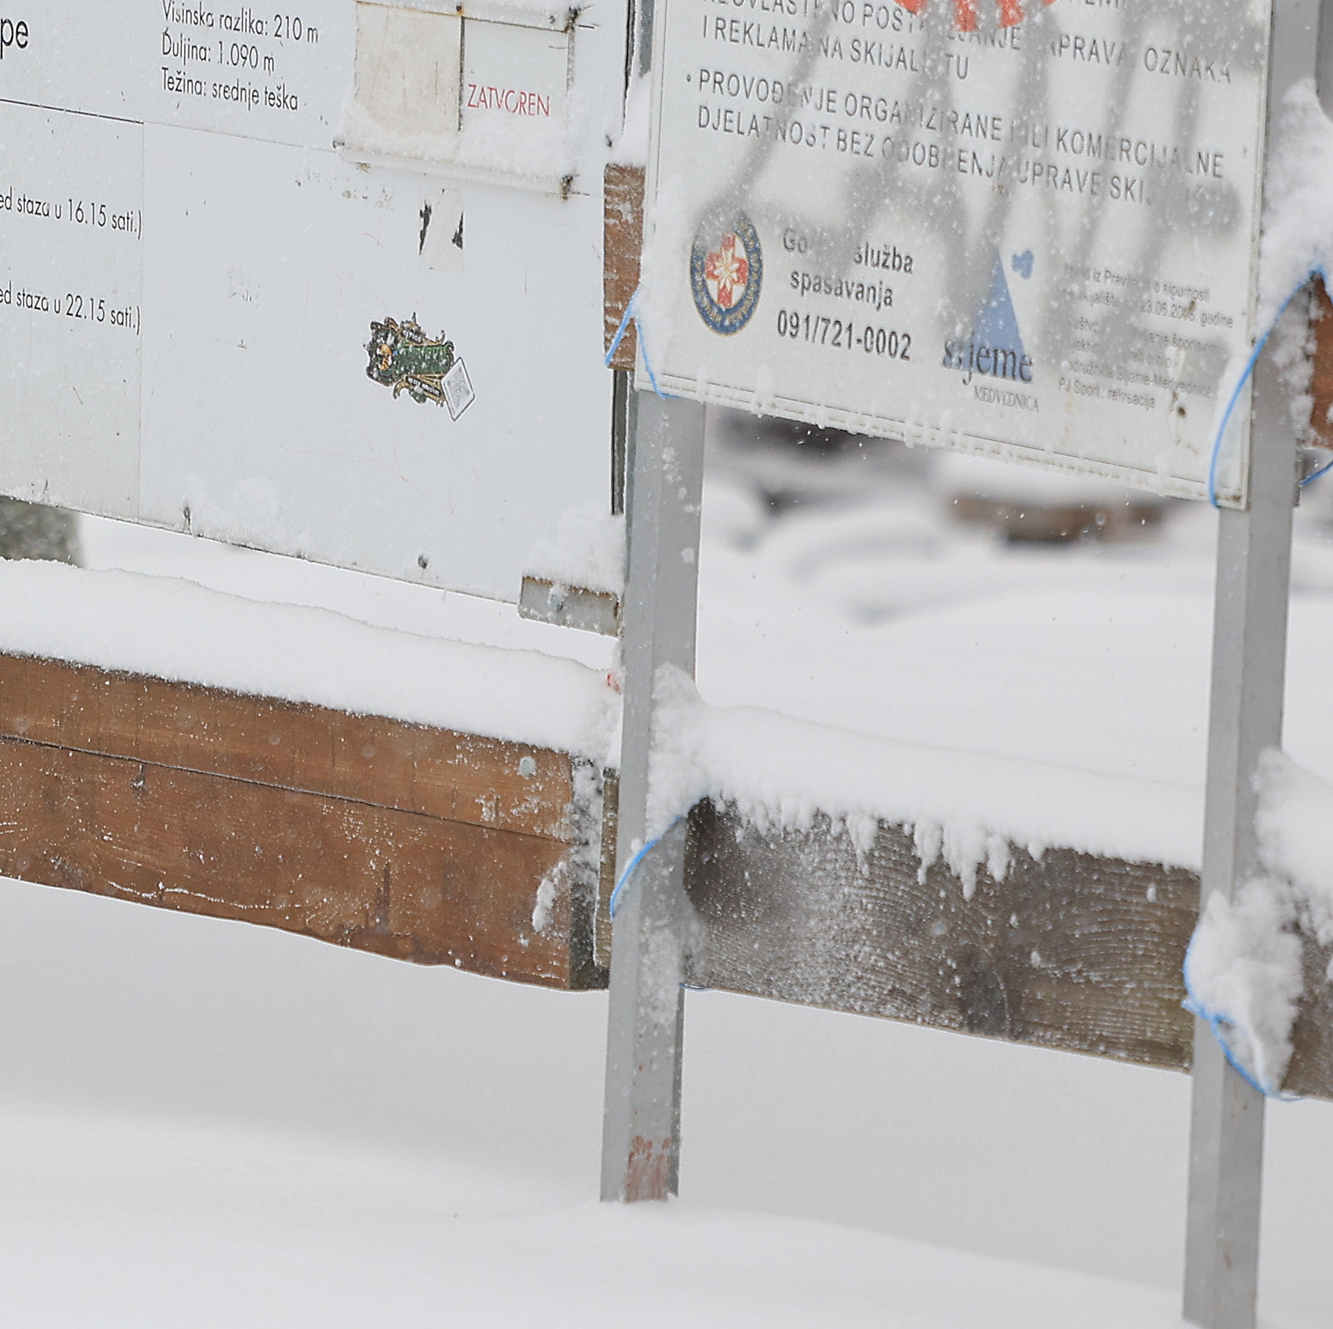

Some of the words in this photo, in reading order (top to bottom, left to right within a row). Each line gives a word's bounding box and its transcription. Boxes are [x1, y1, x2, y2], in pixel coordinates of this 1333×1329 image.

[219, 7, 269, 37] razlika:
[273, 14, 302, 43] 210
[306, 25, 319, 44] m
[715, 16, 812, 54] REKLAMA
[162, 29, 212, 66] Duljina:
[217, 41, 259, 70] 1.090
[263, 54, 275, 73] m
[161, 67, 207, 97] Težina:
[212, 77, 260, 111] srednje
[264, 83, 299, 111] teška
[467, 83, 551, 118] ZATVOREN
[698, 104, 830, 150] DJELATNOST
[836, 127, 874, 158] BEZ
[16, 193, 50, 218] staza
[54, 205, 62, 220] u
[68, 198, 107, 227] 16.15
[111, 210, 143, 241] sati.)
[853, 241, 914, 275] služba
[16, 288, 49, 313] staza
[53, 299, 61, 314] u
[65, 293, 106, 322] 22.15
[109, 305, 141, 336] sati.)
[777, 309, 913, 362] 091/721-0002
